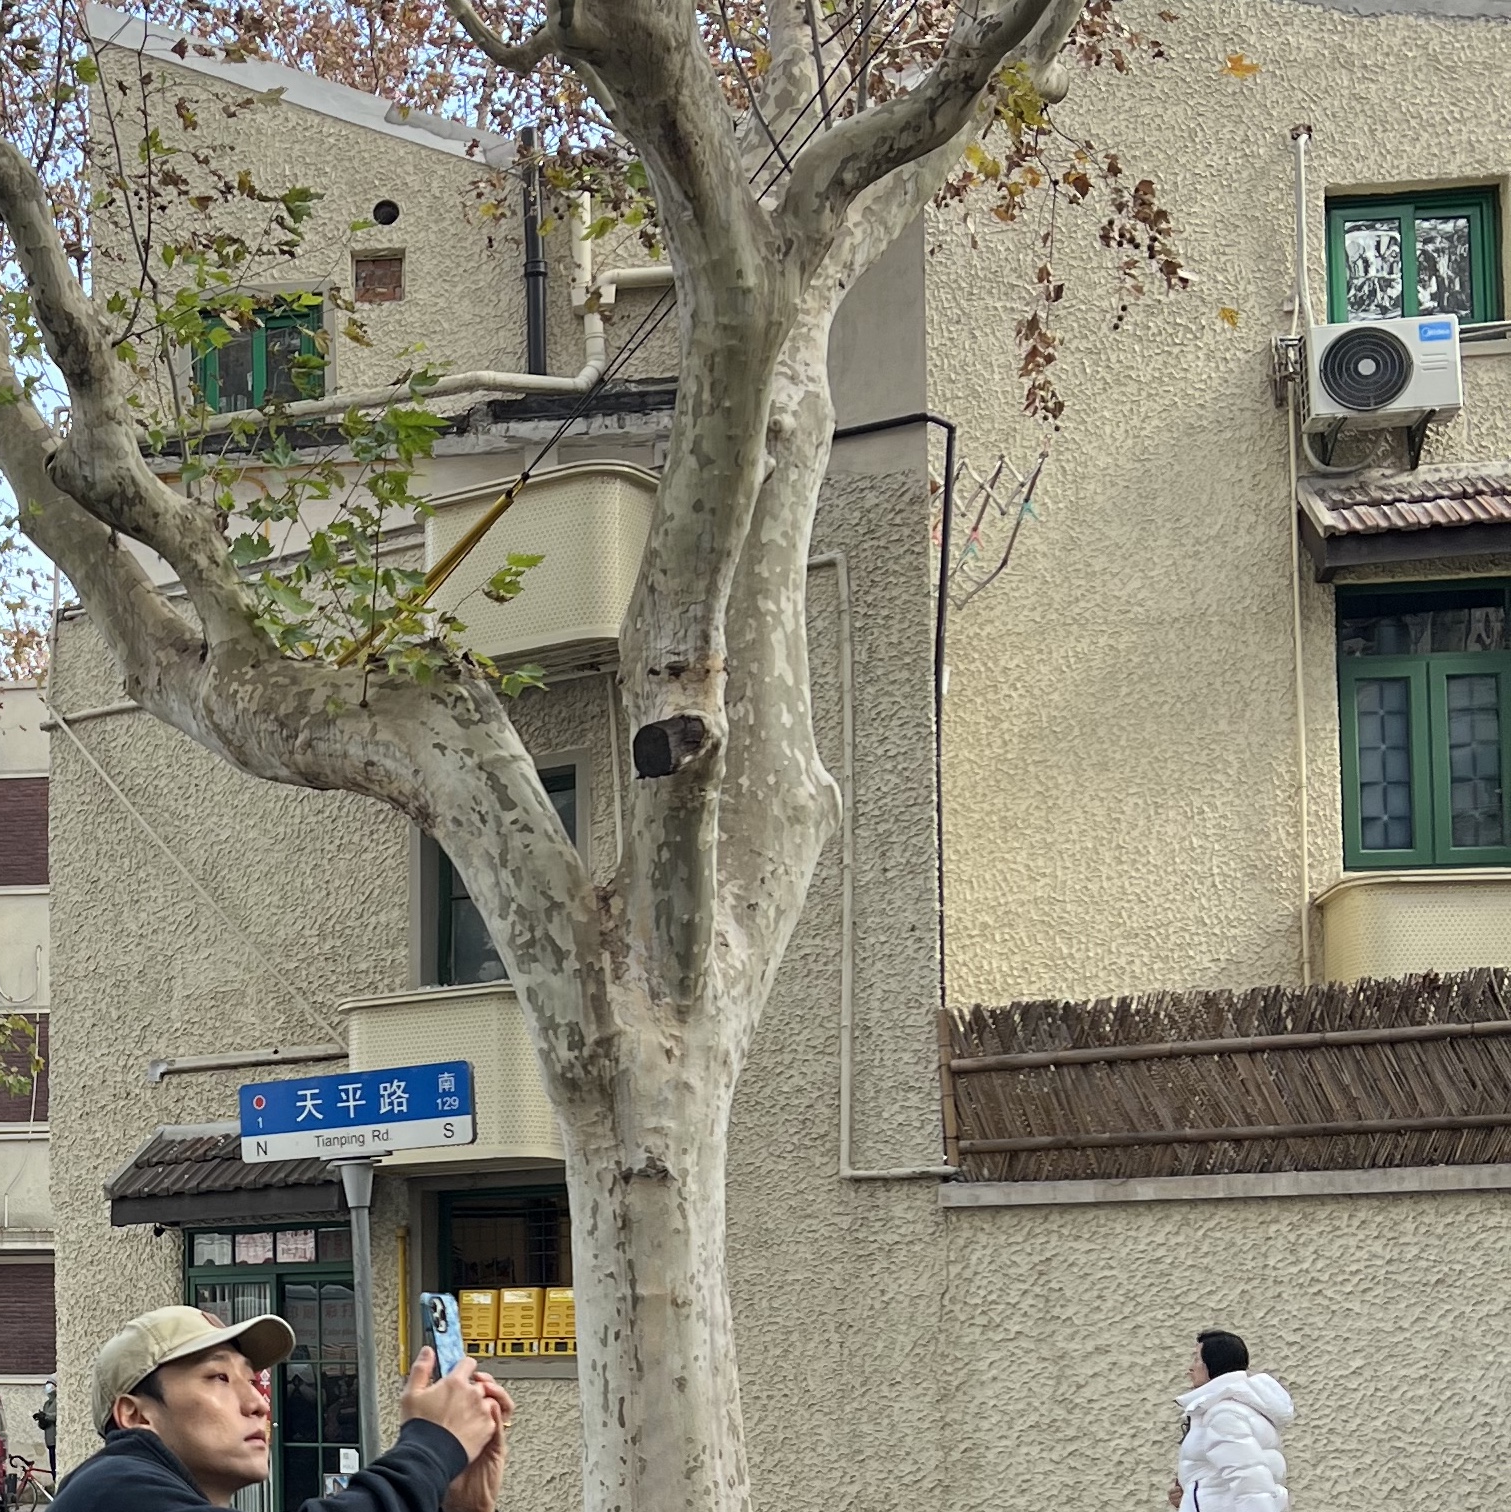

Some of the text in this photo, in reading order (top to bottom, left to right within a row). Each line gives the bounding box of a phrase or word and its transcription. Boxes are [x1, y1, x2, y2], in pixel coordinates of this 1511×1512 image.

[437, 1072, 456, 1093] 南
[295, 1078, 410, 1123] 天平路
[436, 1096, 460, 1111] 129
[256, 1116, 263, 1129] 1
[256, 1140, 268, 1157] N
[314, 1131, 366, 1149] Tianping
[442, 1122, 455, 1139] S
